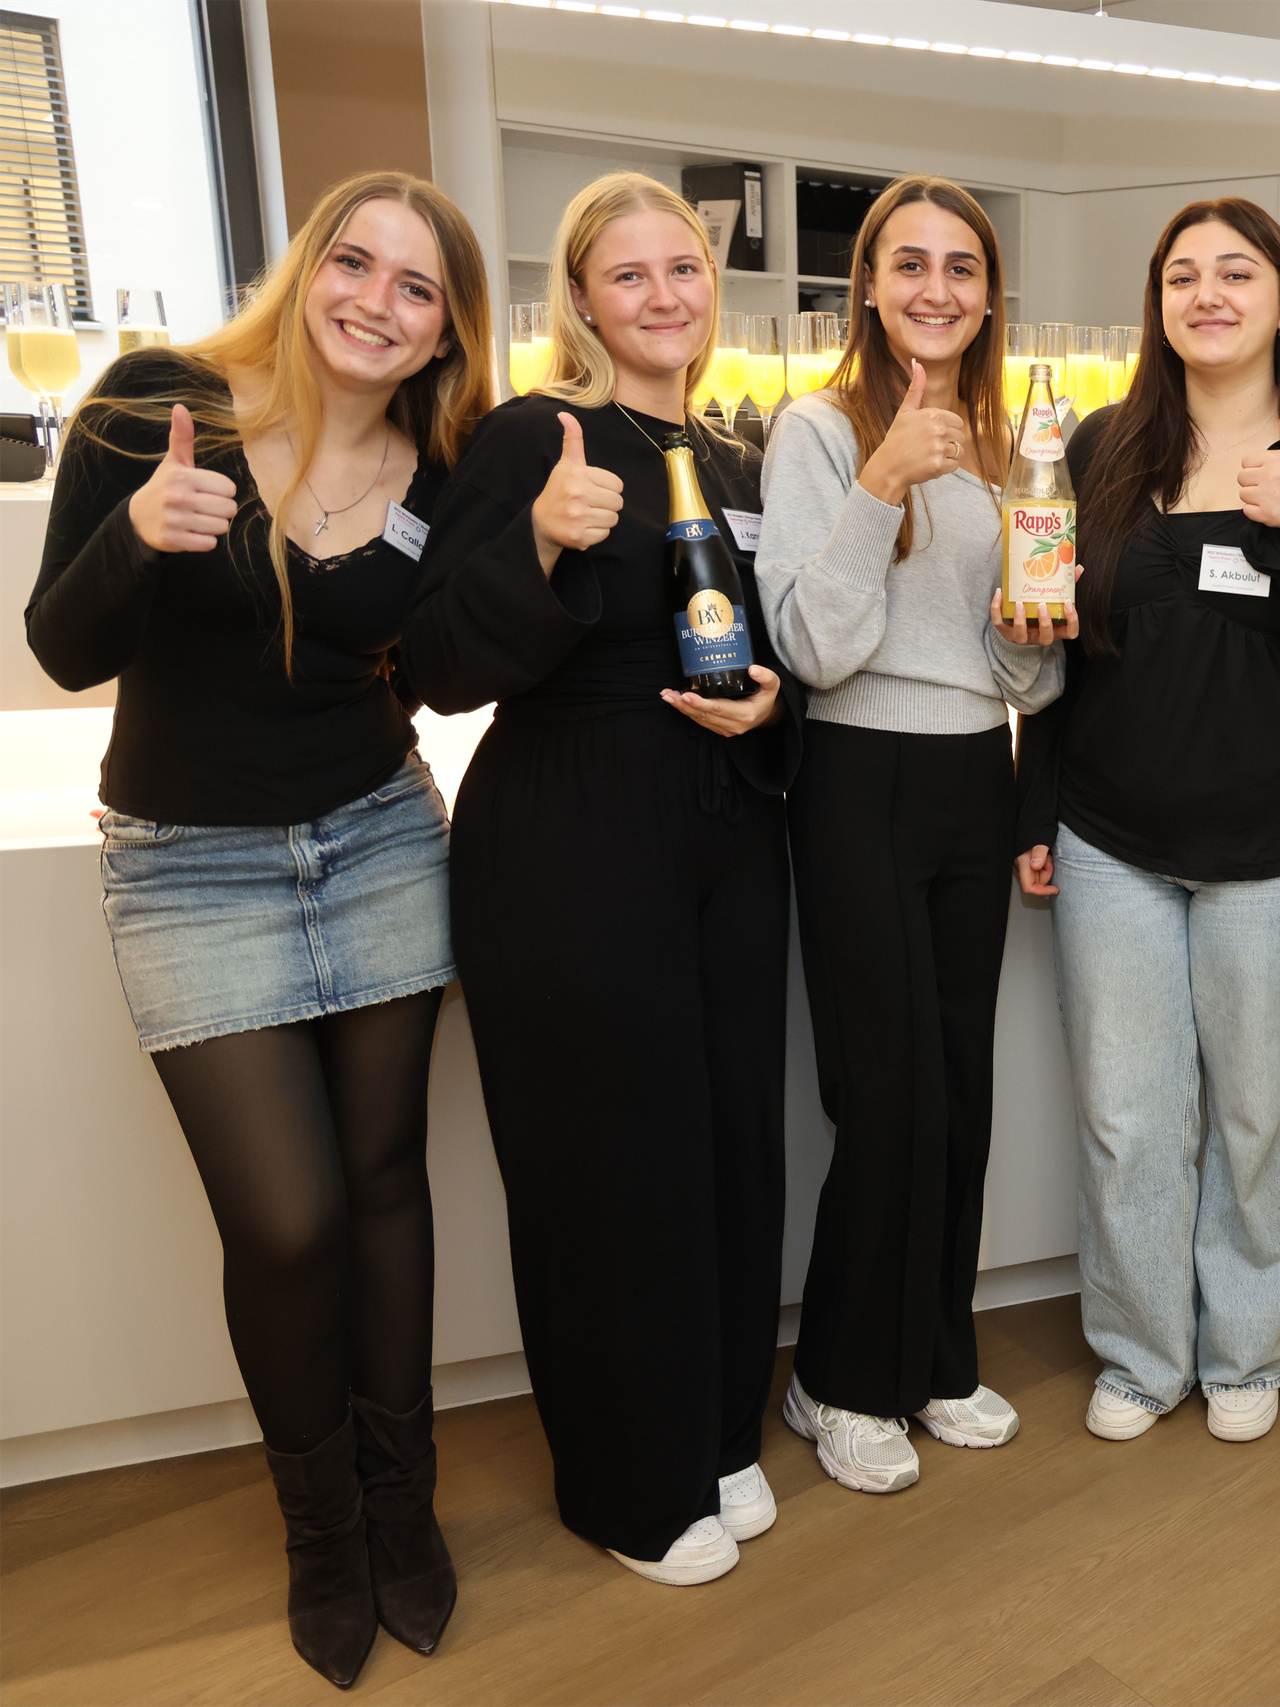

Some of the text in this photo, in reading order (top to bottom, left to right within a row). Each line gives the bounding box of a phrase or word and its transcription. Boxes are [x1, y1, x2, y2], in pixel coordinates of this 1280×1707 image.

[1032, 408, 1053, 419] Rapp's
[391, 523, 398, 534] L.
[1014, 510, 1062, 537] Rapp's
[1209, 568, 1260, 582] S. Akbulut
[1022, 583, 1066, 596] Orangensaft
[697, 609, 723, 625] BW
[681, 622, 744, 640] BURIMER
[694, 632, 736, 646] WINZER
[700, 652, 737, 662] CRÉMANT
